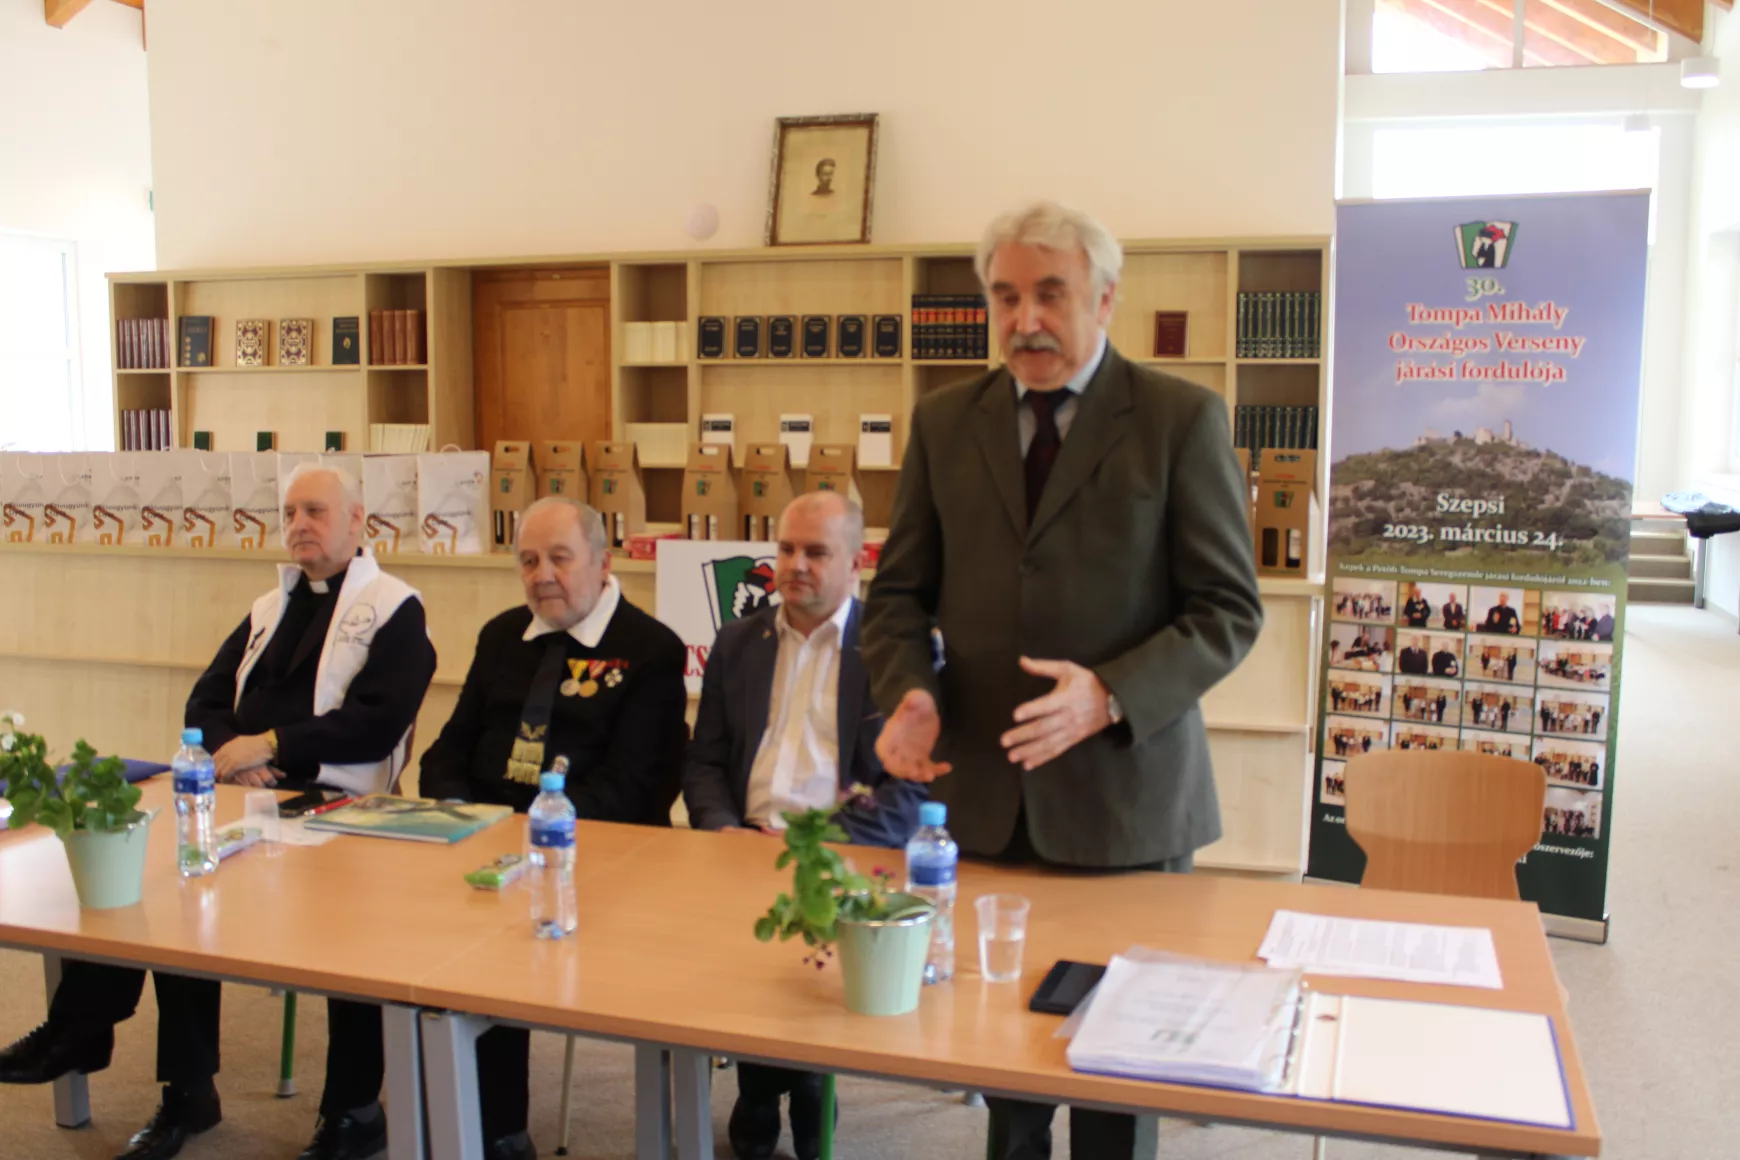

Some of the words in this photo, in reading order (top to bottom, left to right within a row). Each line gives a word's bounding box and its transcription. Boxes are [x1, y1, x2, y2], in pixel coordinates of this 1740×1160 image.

[1466, 277, 1504, 301] 30.
[1406, 302, 1483, 329] Tompa
[1487, 301, 1569, 330] Mihály
[1387, 331, 1489, 357] Országos
[1493, 331, 1586, 358] Verseny
[1395, 359, 1456, 385] járási
[1460, 359, 1567, 387] fordulója
[1436, 492, 1505, 519] Szepsi
[1383, 523, 1434, 544] 2023.
[1439, 522, 1528, 545] március
[1532, 531, 1564, 551] 24.
[1534, 843, 1595, 860] őszervezője:
